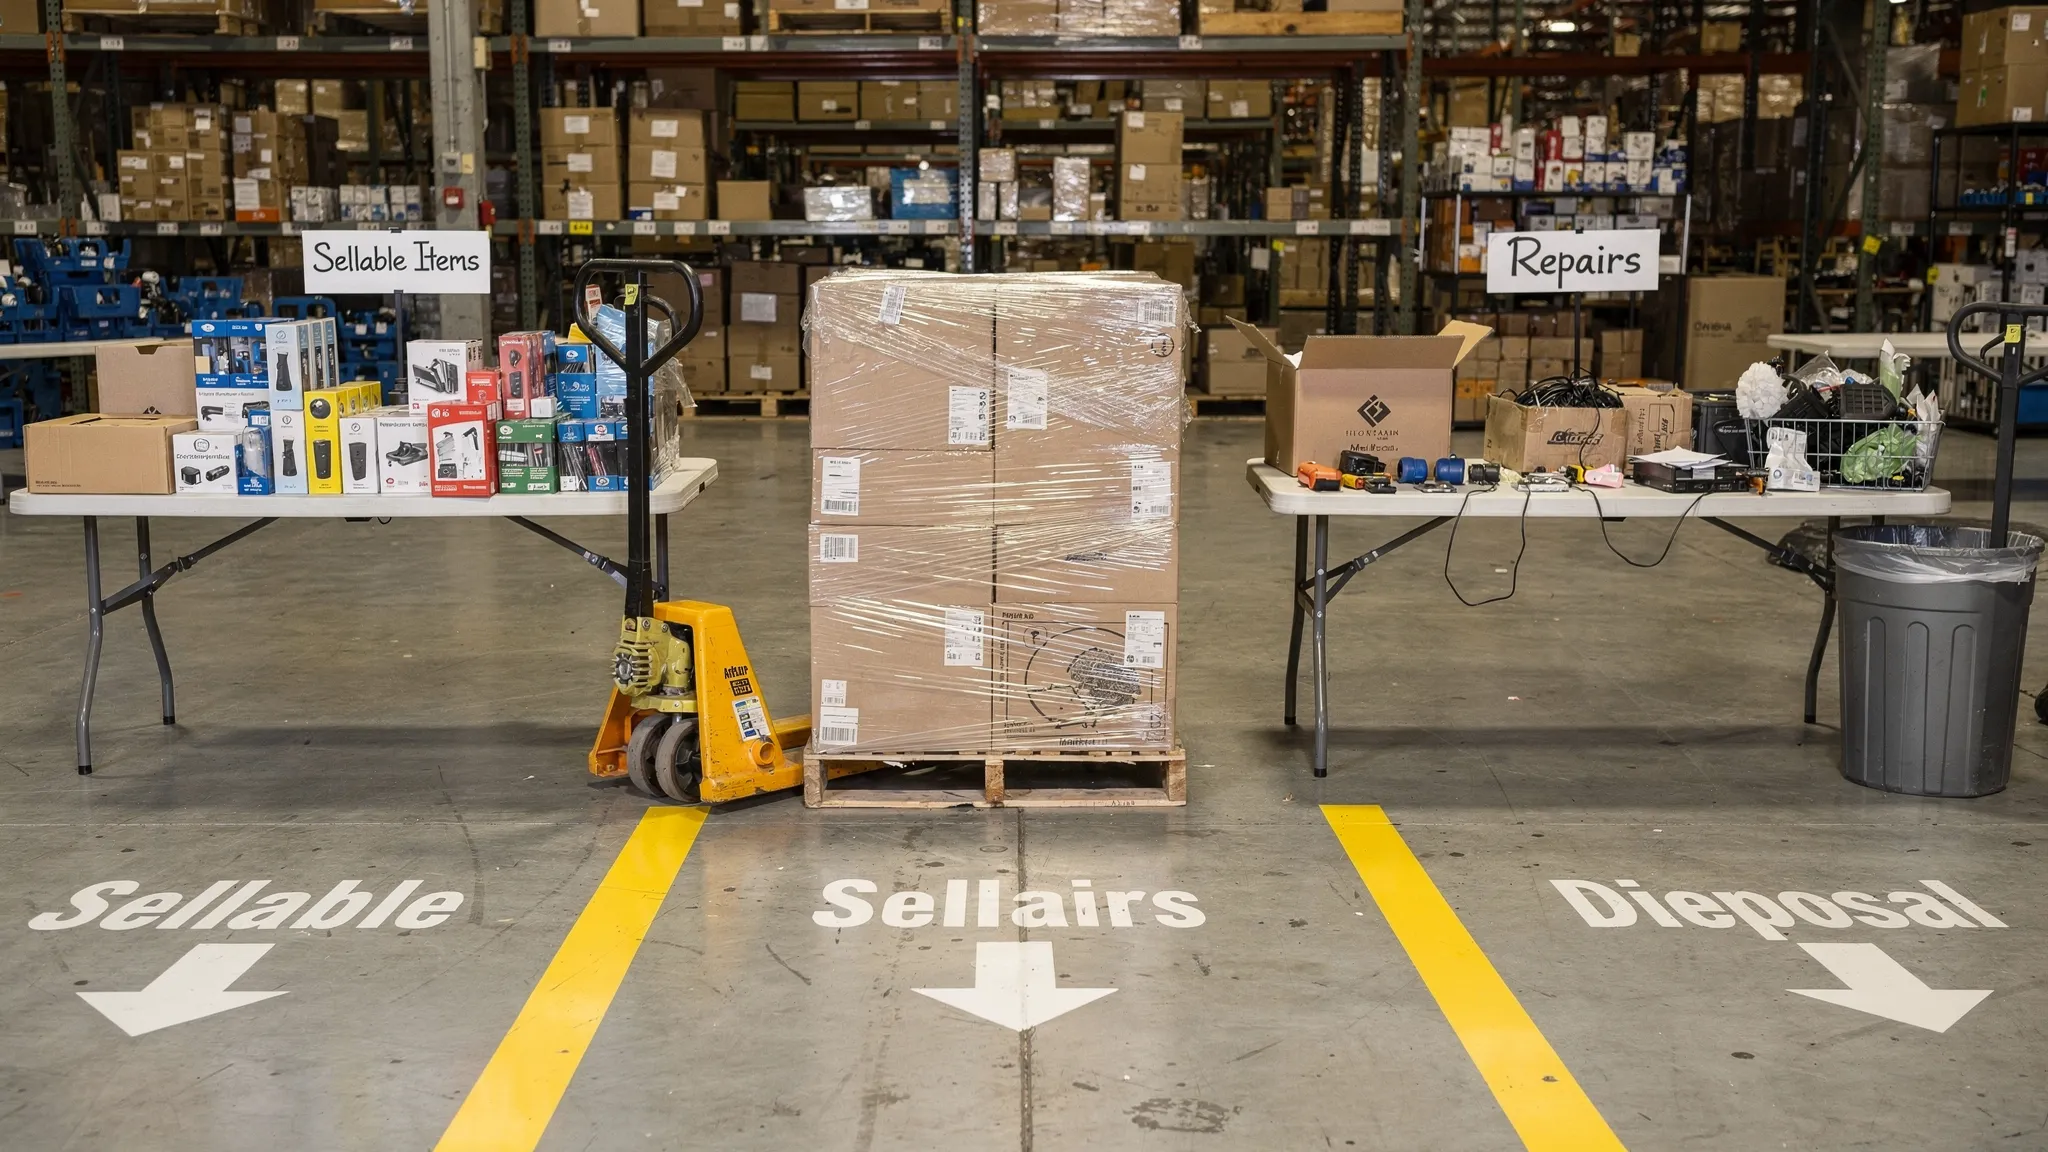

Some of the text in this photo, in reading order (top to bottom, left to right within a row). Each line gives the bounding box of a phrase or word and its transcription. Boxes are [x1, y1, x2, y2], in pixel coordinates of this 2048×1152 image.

[313, 240, 480, 273] Sellable Items
[1506, 235, 1641, 289] Repairs
[28, 879, 465, 931] Sellable
[812, 878, 1207, 929] Sellairs
[1549, 879, 2009, 941] Dieposal
